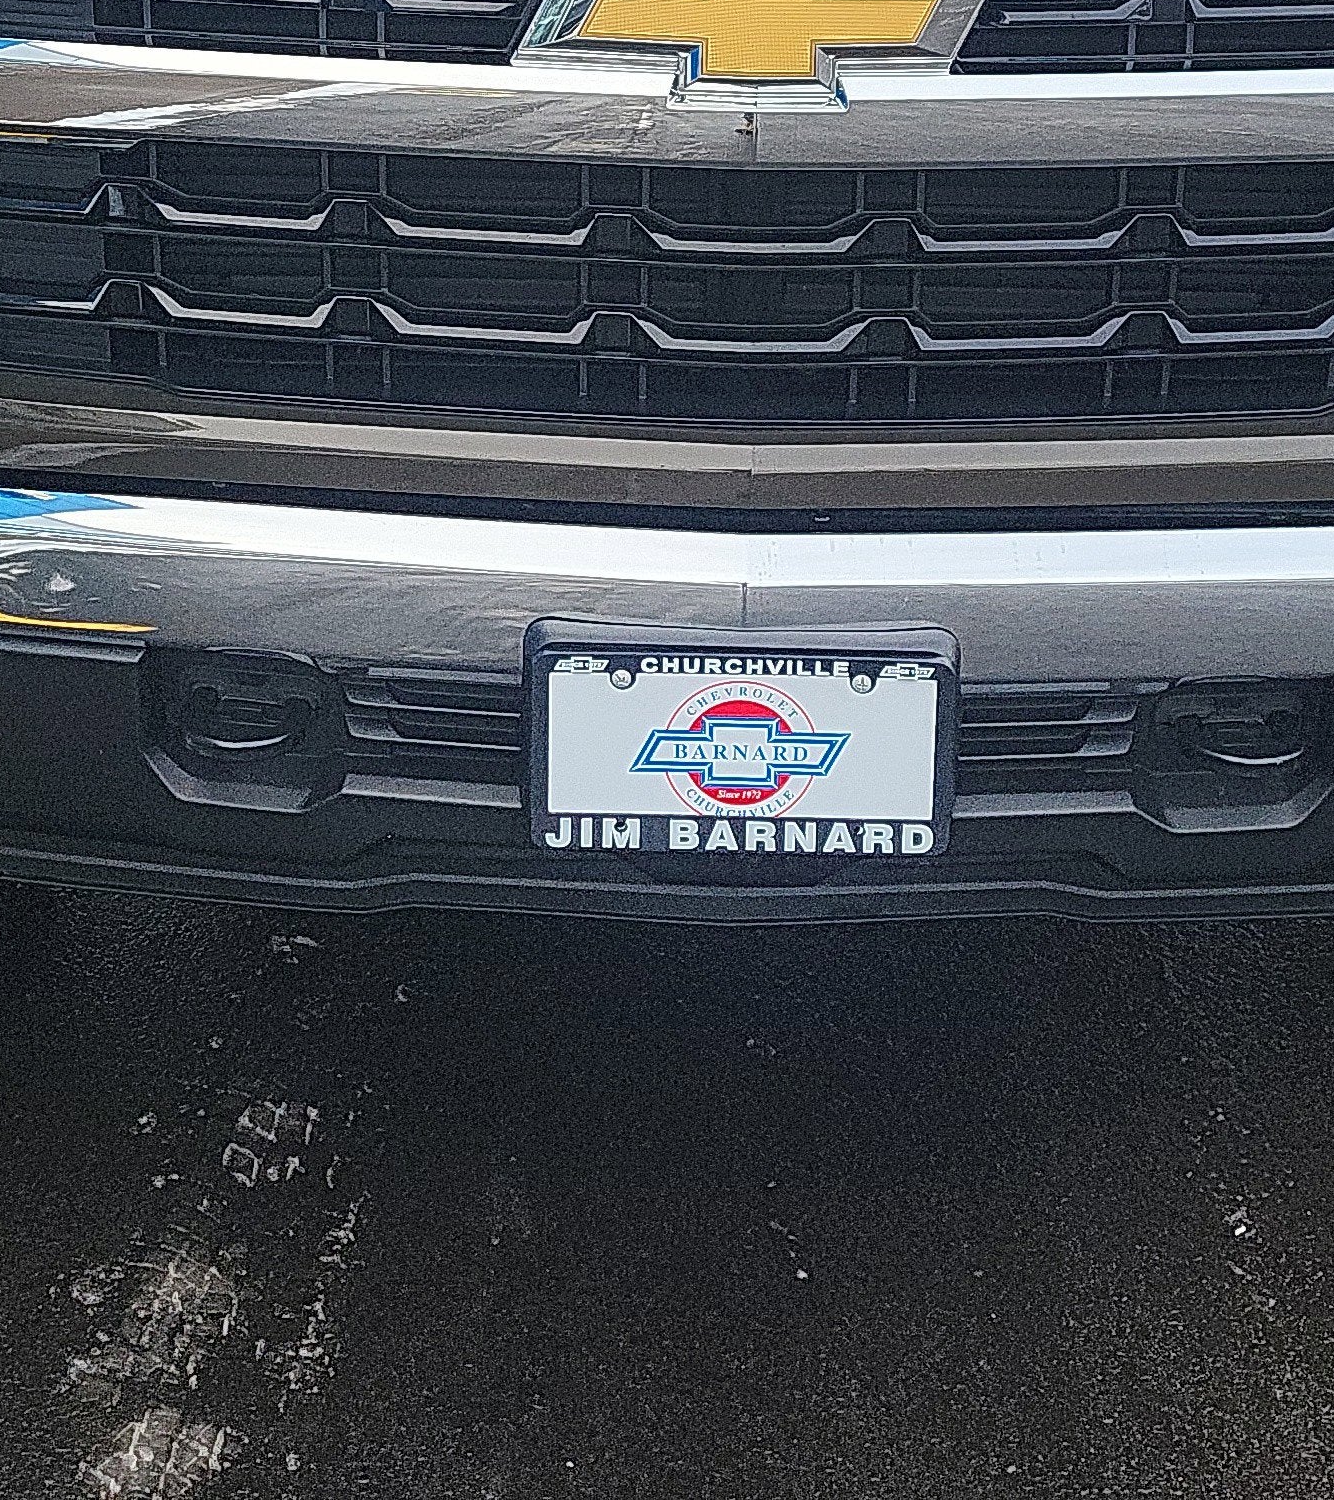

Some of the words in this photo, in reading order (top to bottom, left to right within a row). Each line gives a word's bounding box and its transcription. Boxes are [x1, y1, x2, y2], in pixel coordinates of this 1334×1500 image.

[640, 657, 850, 678] CHURCHVILLE
[686, 686, 799, 719] CHEVROLET
[673, 743, 808, 762] BARNARD
[686, 788, 795, 818] CHURCHVILLE
[544, 816, 641, 849] JIM
[669, 818, 934, 854] BARNARD
